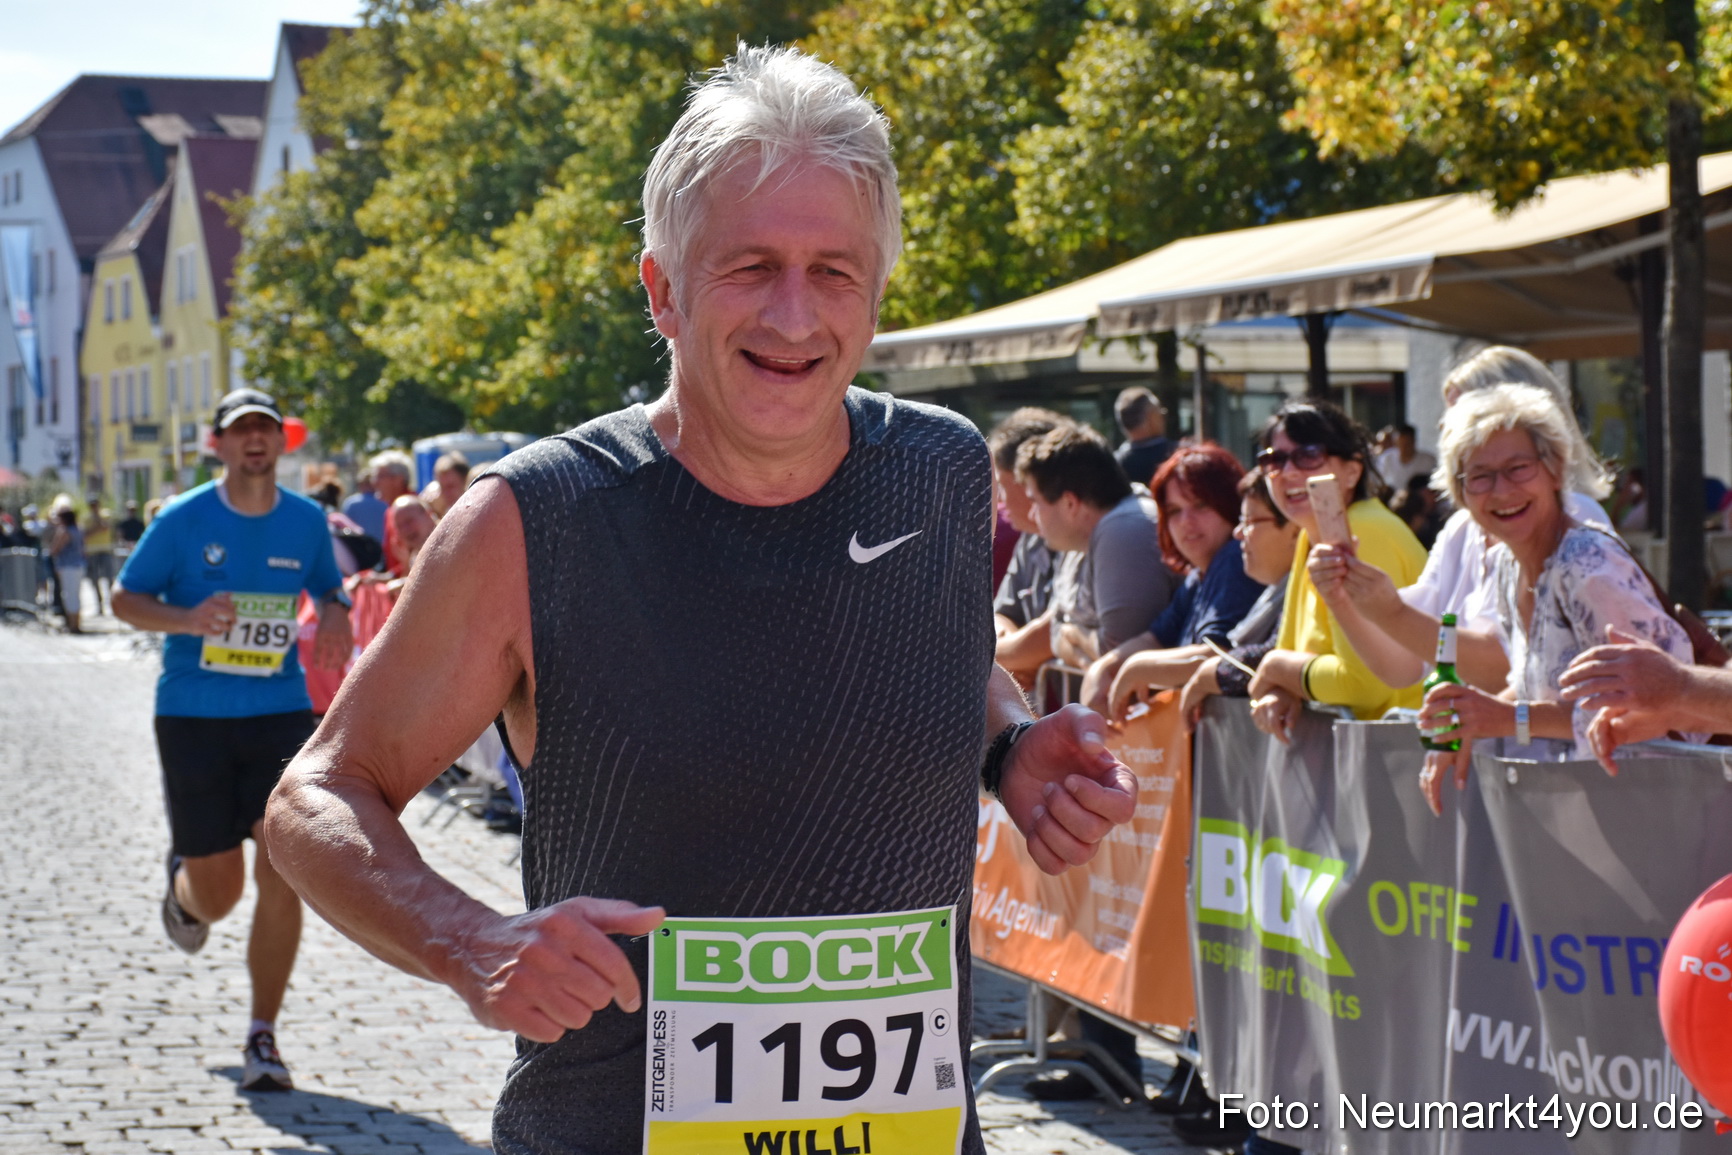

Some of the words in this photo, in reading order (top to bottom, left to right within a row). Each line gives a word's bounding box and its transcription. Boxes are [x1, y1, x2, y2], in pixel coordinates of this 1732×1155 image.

[233, 597, 290, 613] OCK
[227, 652, 272, 666] PETER
[1200, 830, 1338, 959] BCK
[680, 923, 931, 991] BOCK
[934, 1014, 946, 1030] C
[692, 1012, 924, 1104] 1197
[743, 1121, 871, 1155] WILLI
